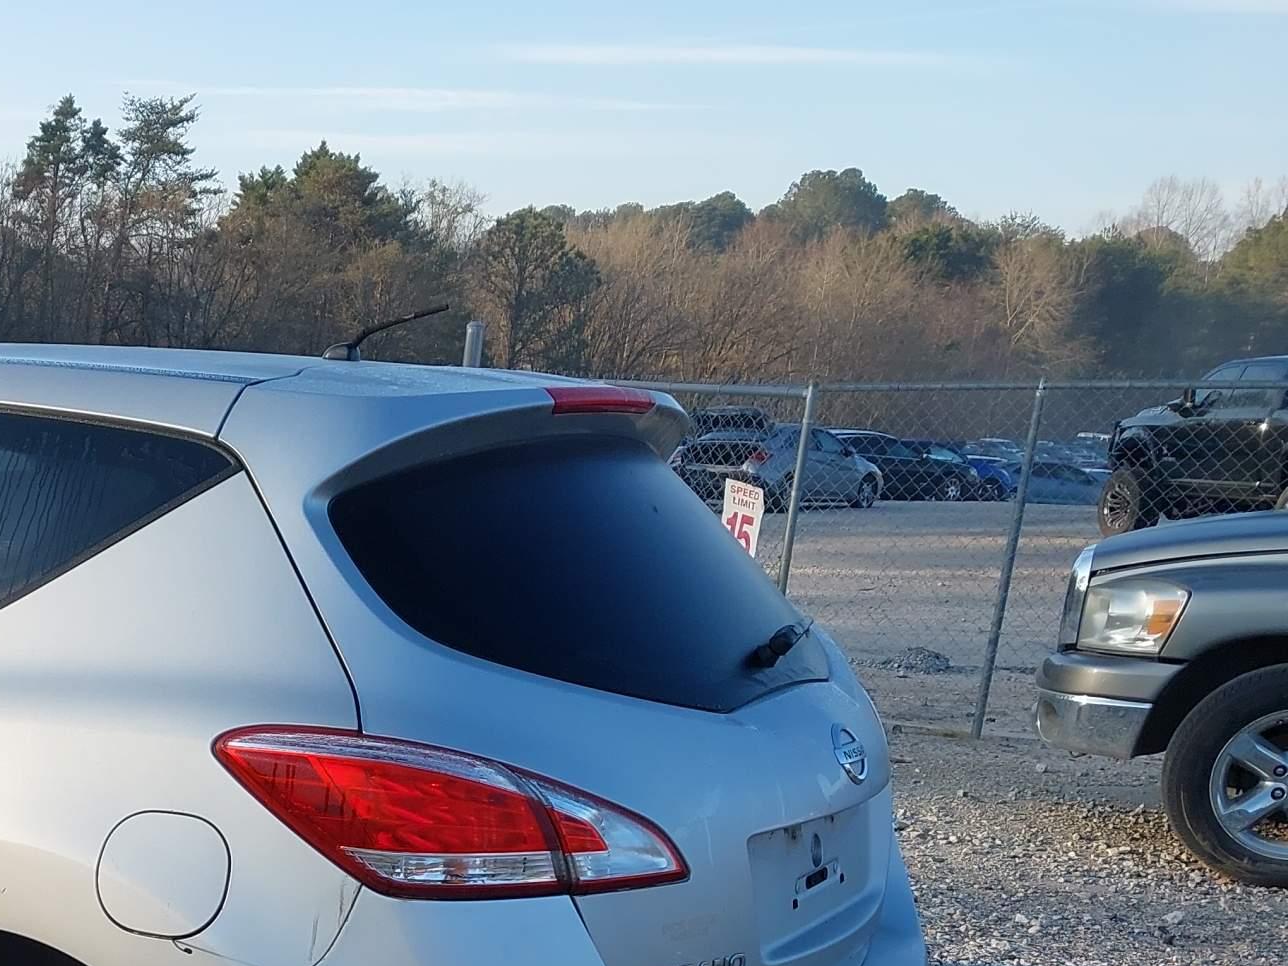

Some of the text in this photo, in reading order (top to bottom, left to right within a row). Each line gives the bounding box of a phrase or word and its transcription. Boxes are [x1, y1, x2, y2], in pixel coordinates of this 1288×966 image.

[730, 484, 760, 501] SPEED
[732, 496, 756, 511] LIMIT
[726, 511, 755, 553] 15
